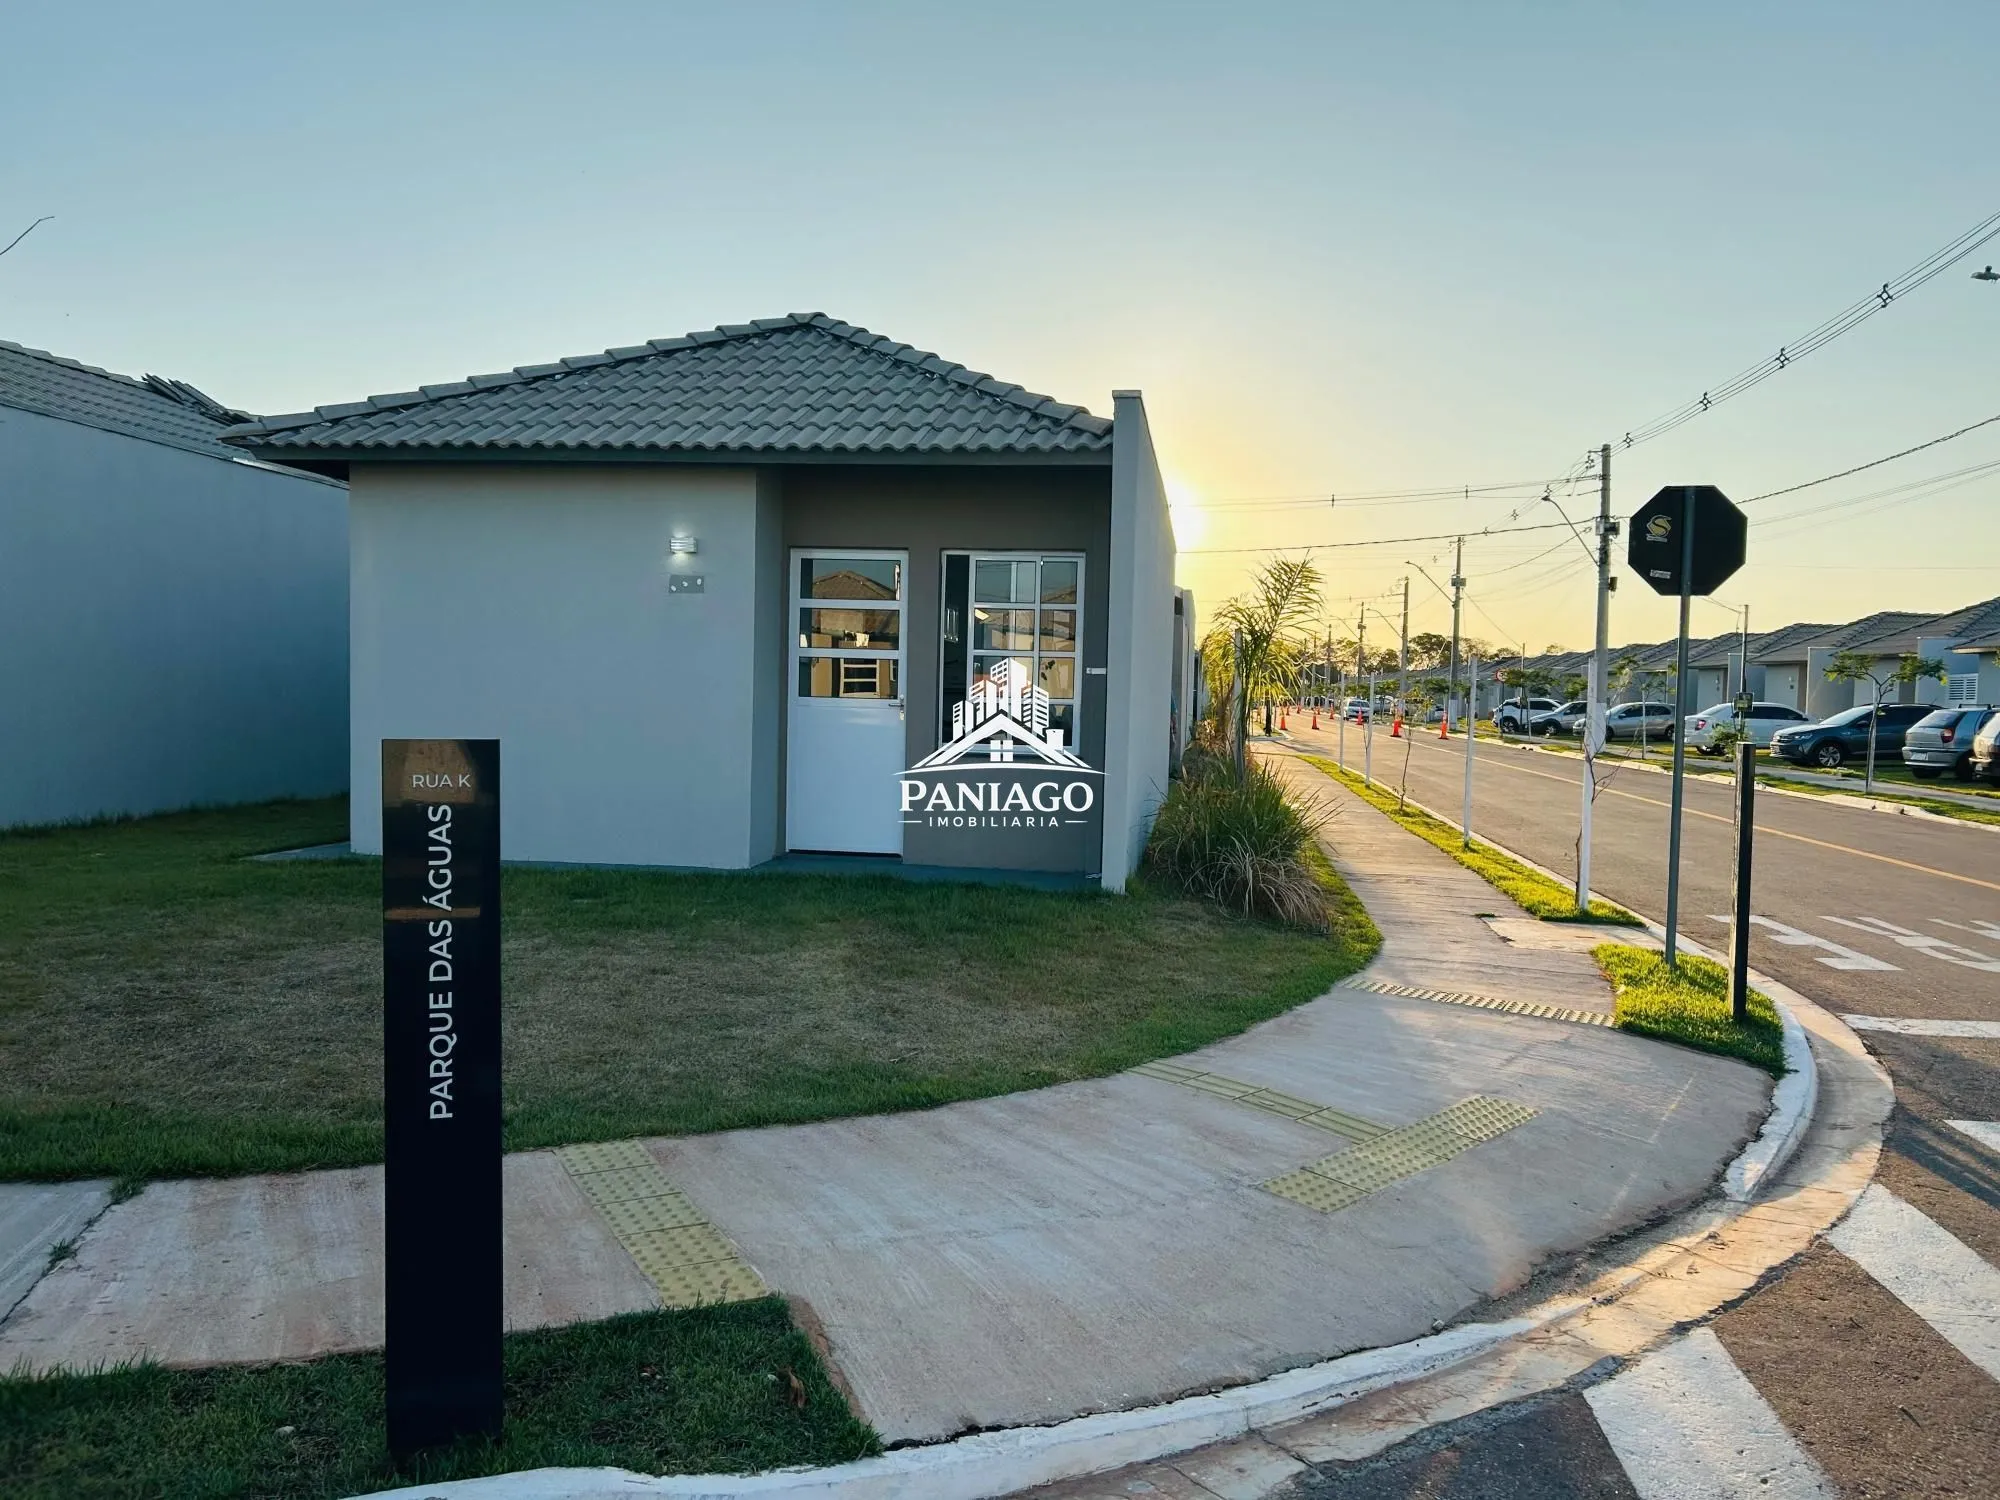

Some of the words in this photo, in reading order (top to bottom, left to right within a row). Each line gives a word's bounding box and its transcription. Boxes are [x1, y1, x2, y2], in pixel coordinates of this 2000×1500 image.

[412, 774, 453, 788] RUA
[458, 774, 471, 788] K
[422, 804, 452, 911] ÁGUAS
[428, 919, 453, 982] DAS
[429, 991, 457, 1120] PARQUE
